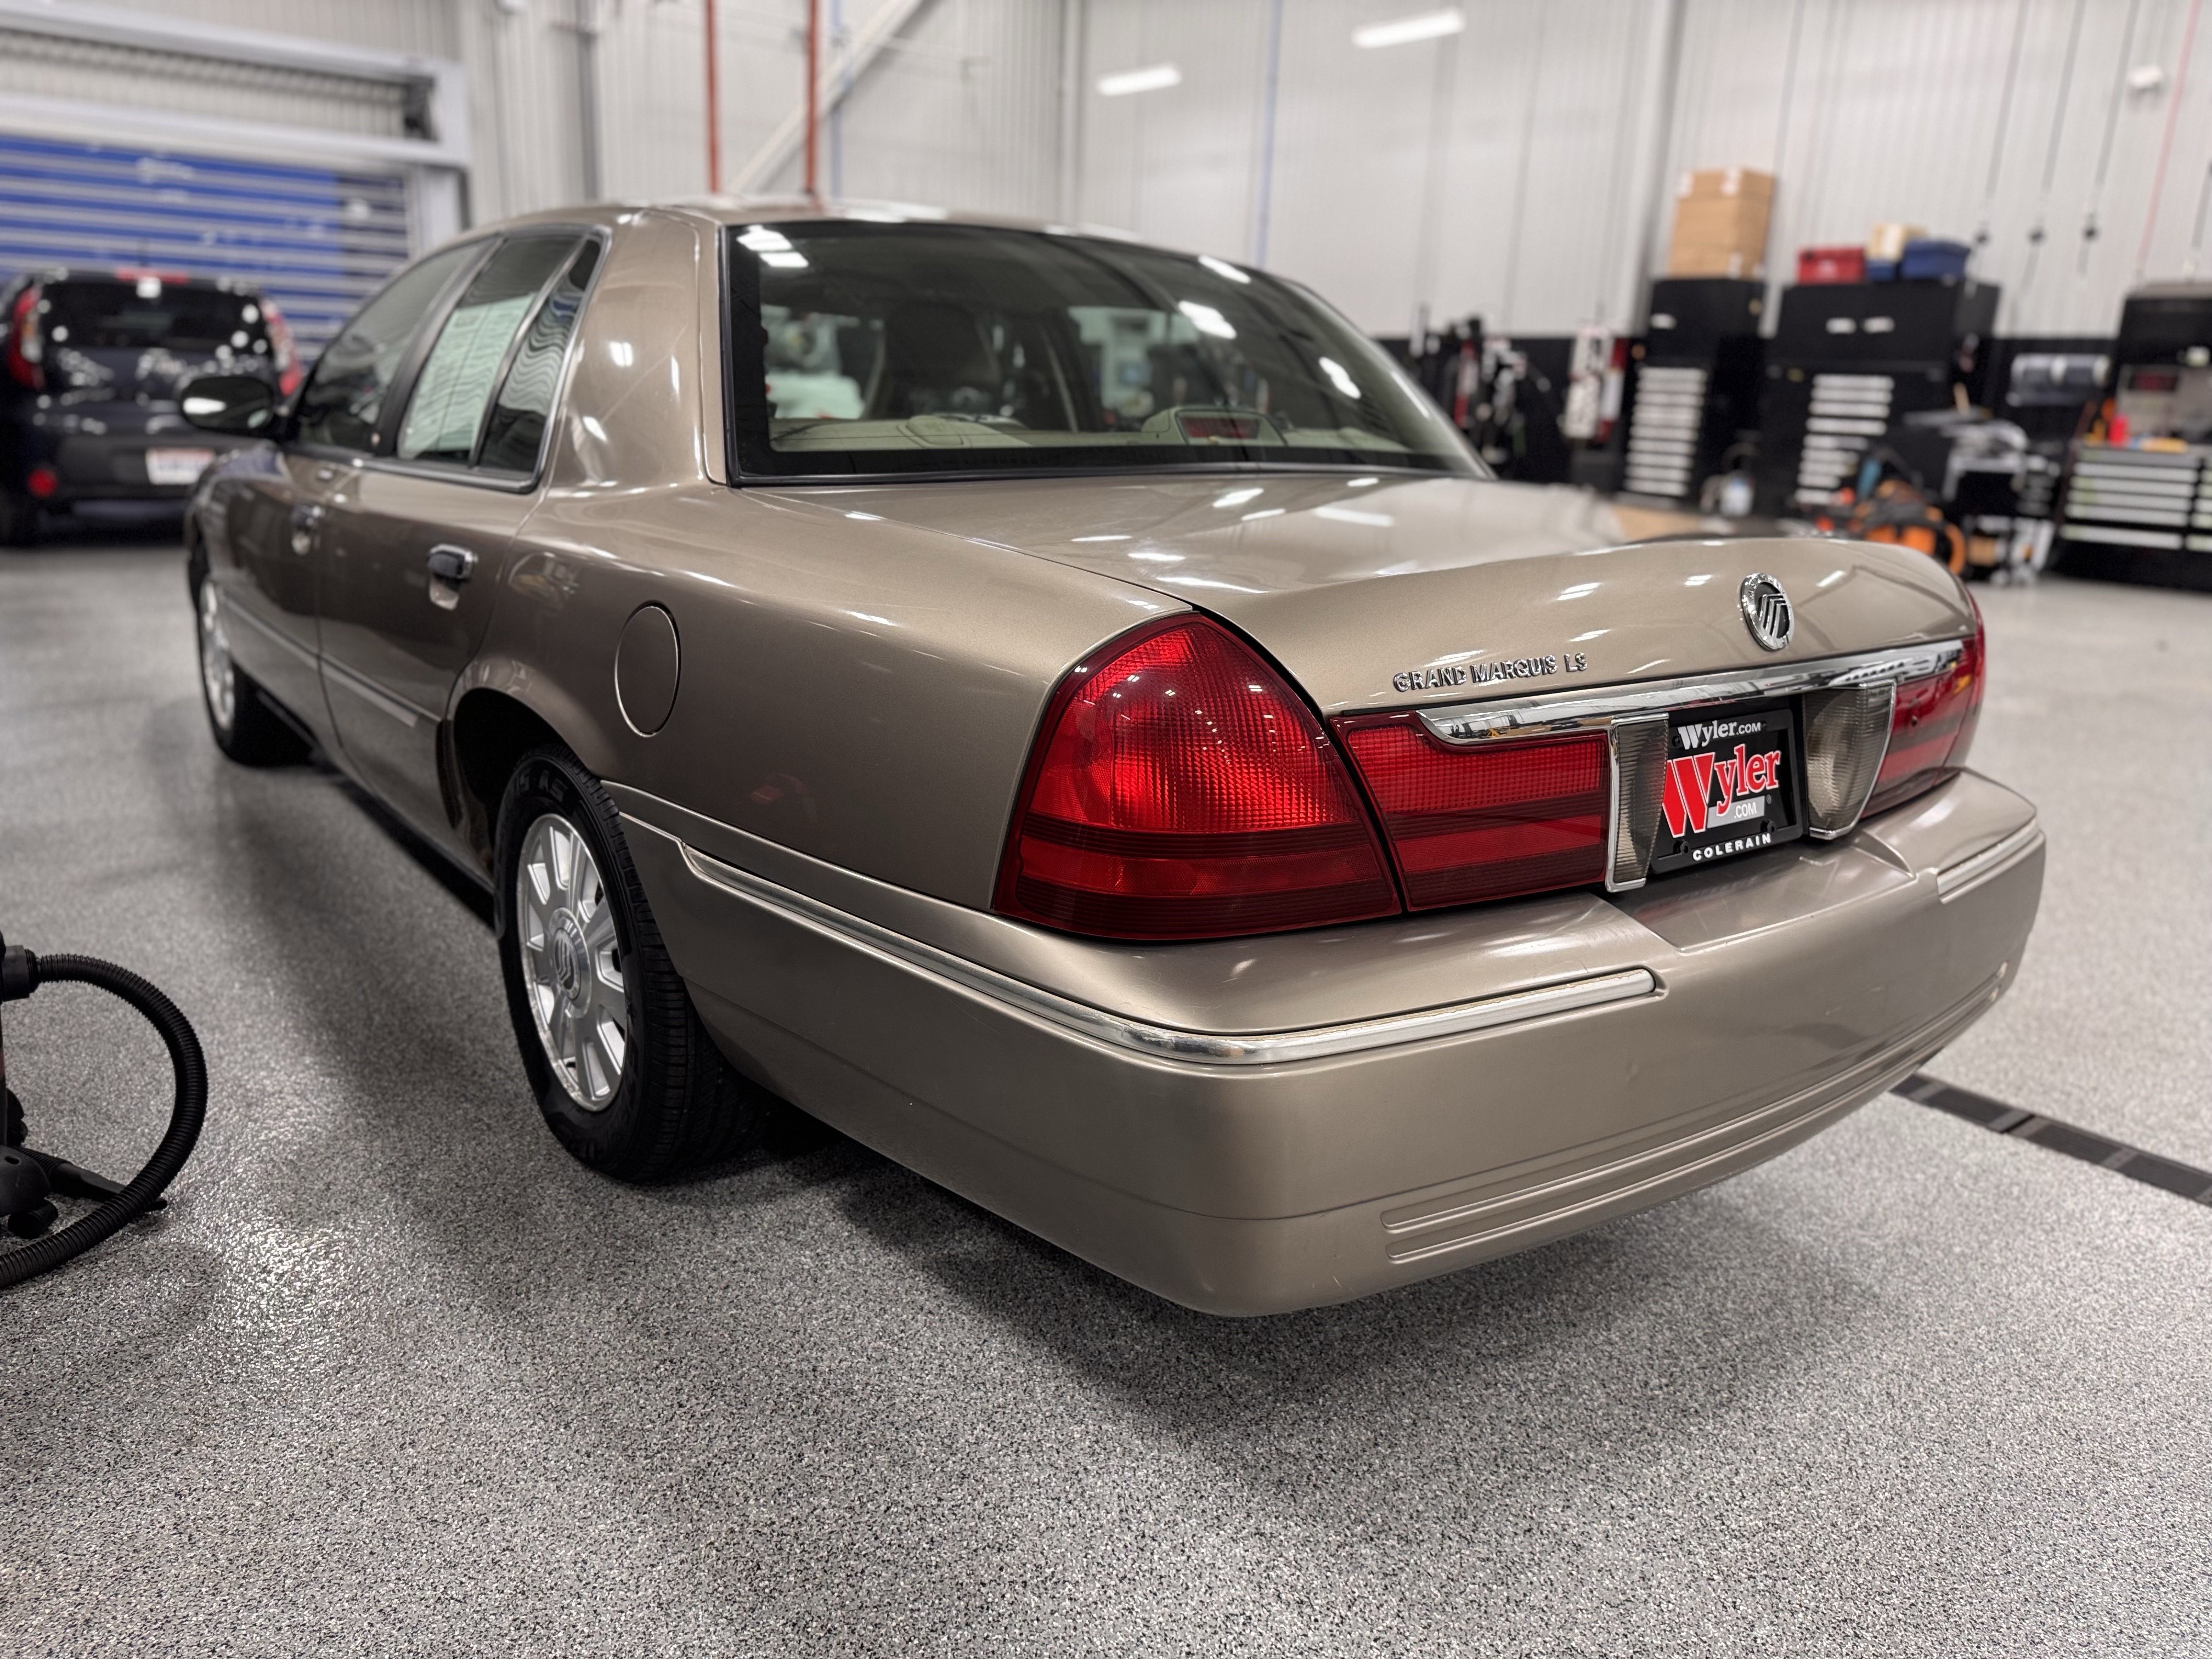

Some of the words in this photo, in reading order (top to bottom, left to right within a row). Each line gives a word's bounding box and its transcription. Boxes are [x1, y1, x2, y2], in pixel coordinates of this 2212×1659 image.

[1393, 666, 1467, 692] GRAND
[1470, 655, 1558, 683] MARQUIS
[1564, 652, 1588, 673] LS
[1662, 743, 1781, 838] Wyler
[1692, 833, 1771, 861] COLERAIN
